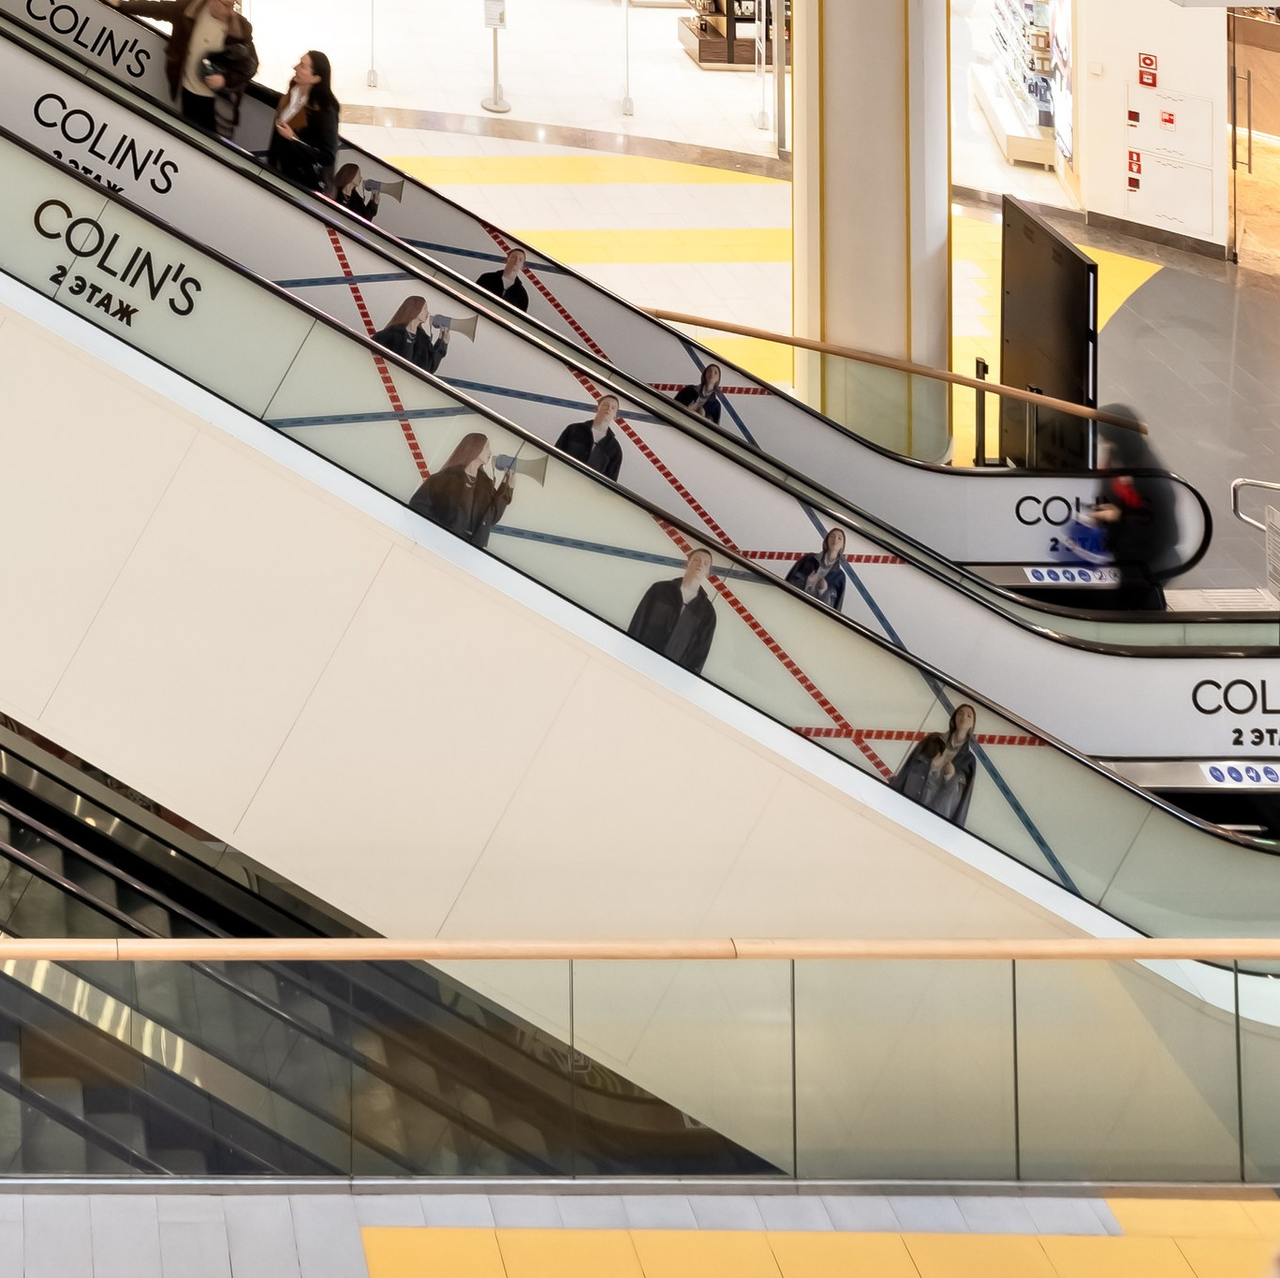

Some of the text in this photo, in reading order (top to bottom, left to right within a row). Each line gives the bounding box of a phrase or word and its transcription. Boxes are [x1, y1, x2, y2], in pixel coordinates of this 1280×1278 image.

[33, 93, 179, 194] COLIN'S
[33, 199, 202, 316] COLIN'S
[48, 264, 140, 327] 2 ЭТАЖ
[1231, 728, 1280, 746] 2 ЭТ
